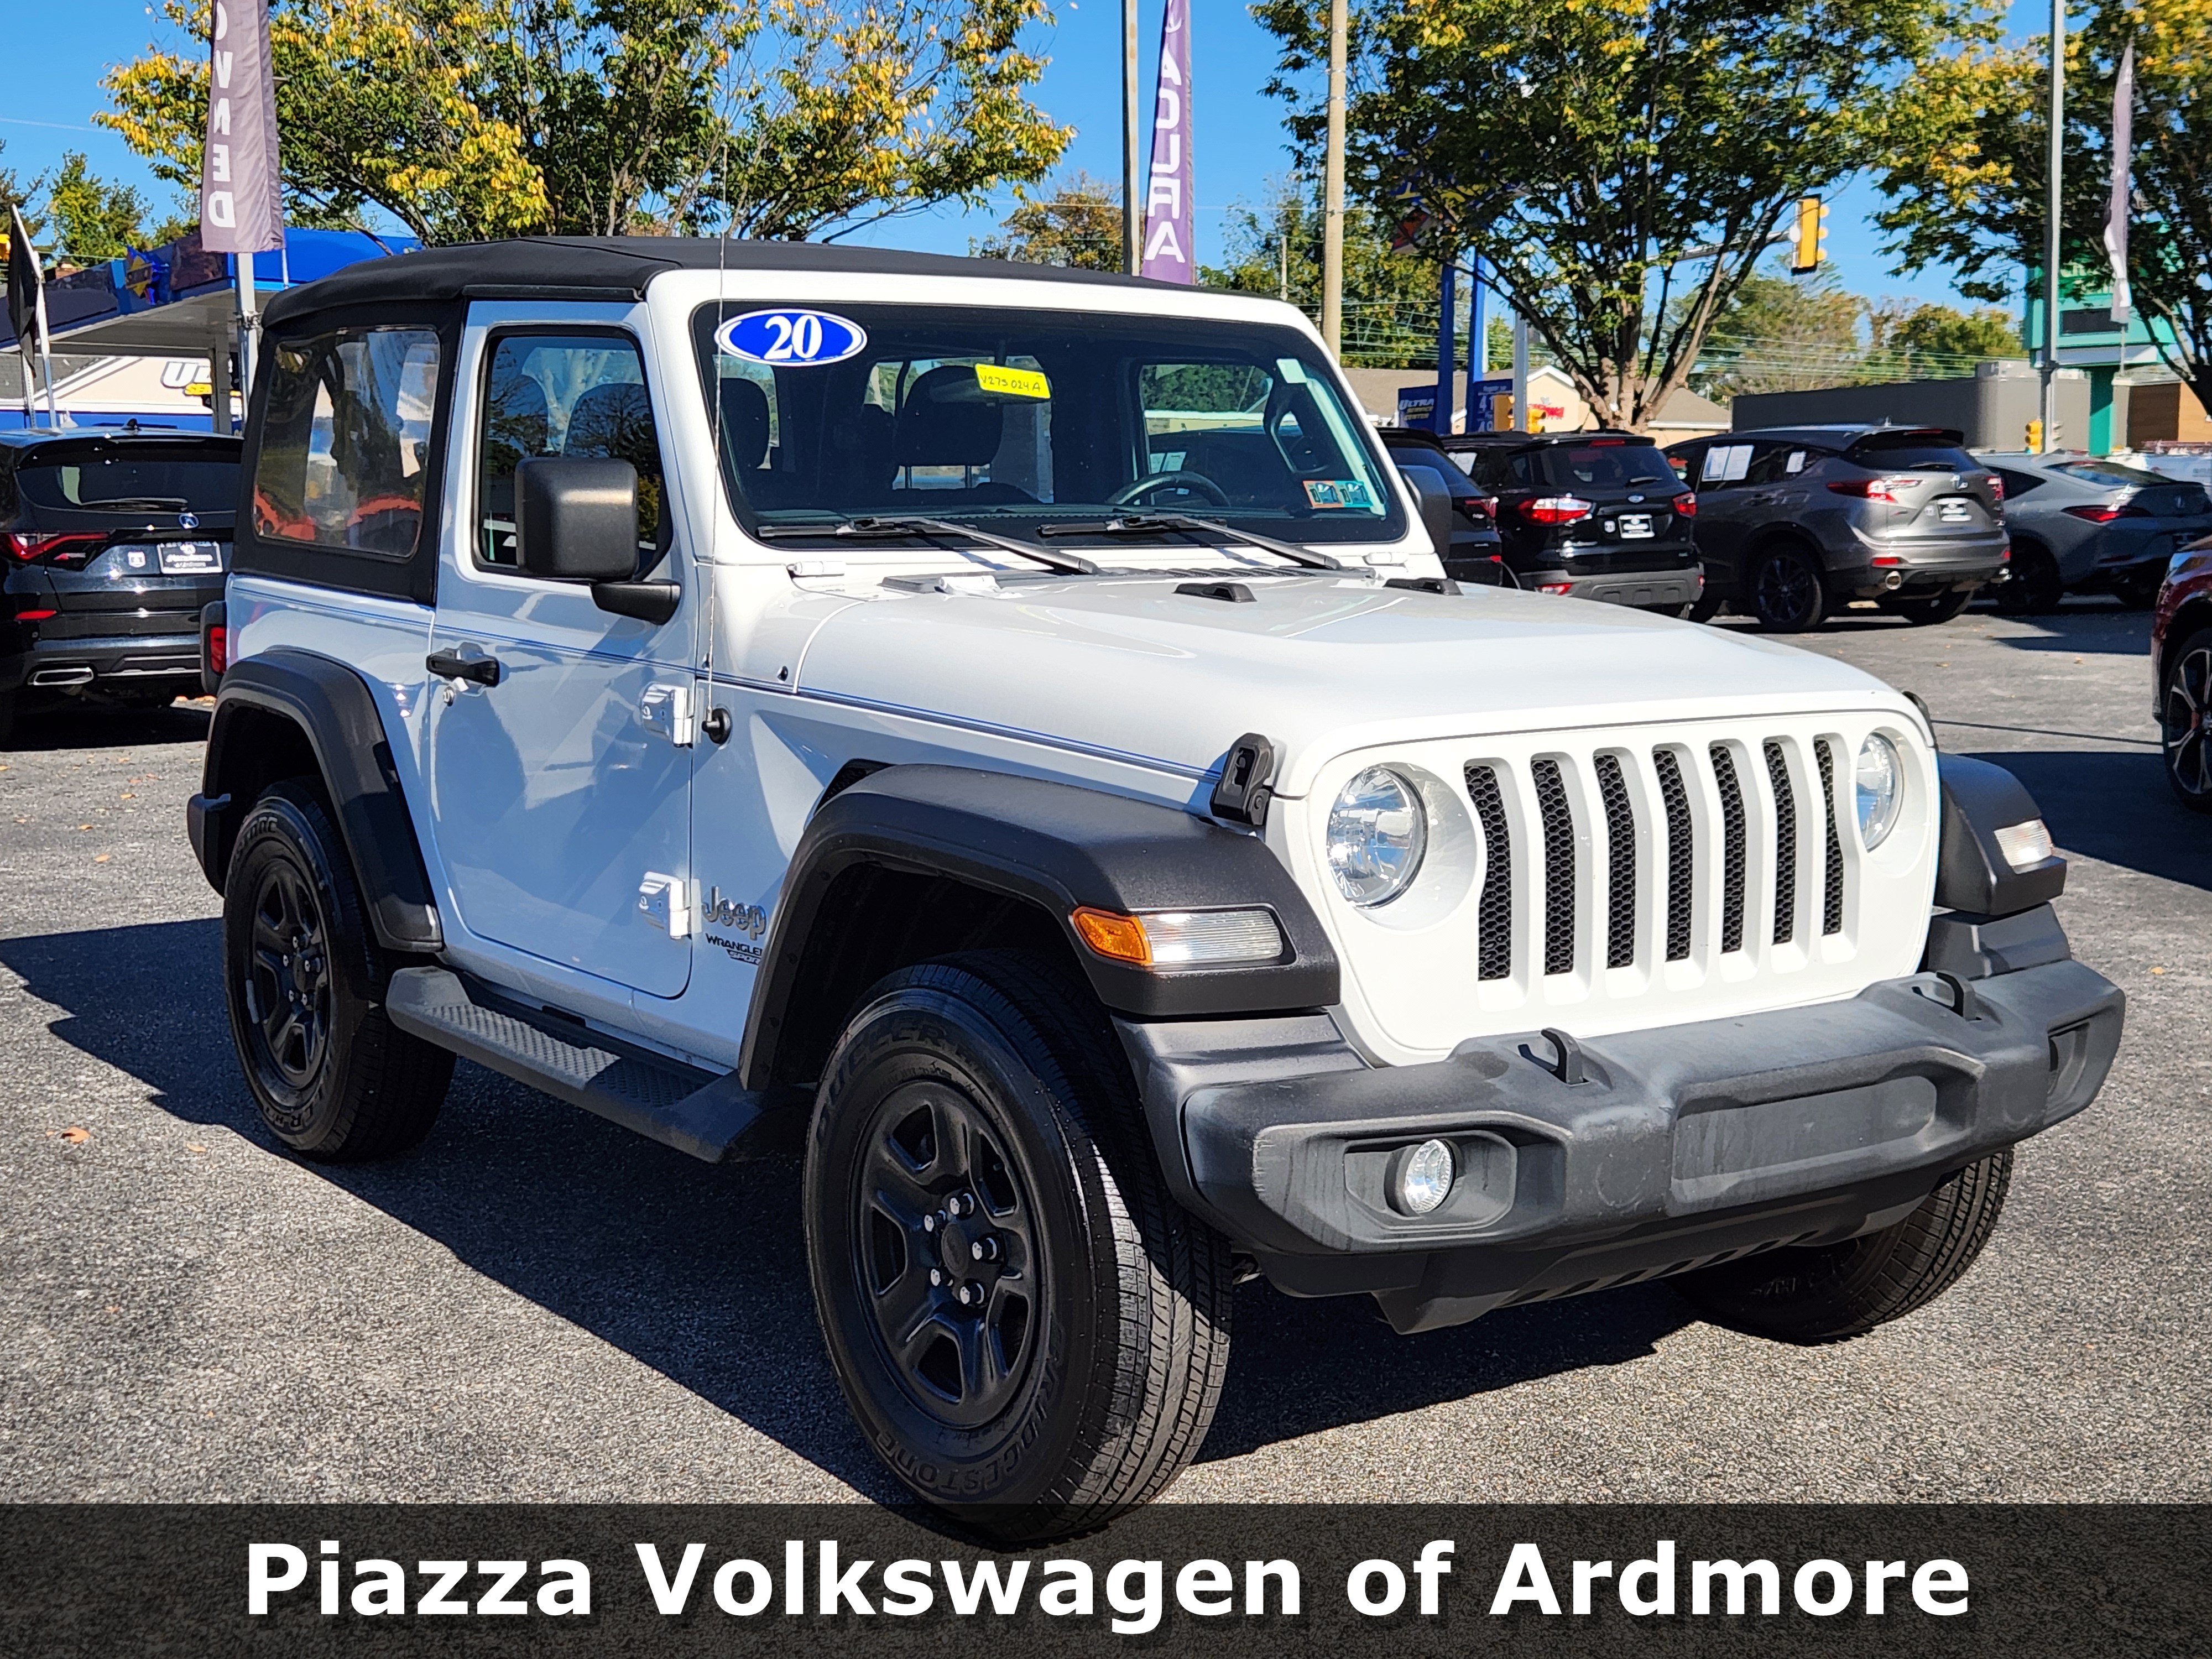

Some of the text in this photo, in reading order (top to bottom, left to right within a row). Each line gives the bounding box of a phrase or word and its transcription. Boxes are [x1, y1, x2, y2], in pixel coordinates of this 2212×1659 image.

[764, 314, 822, 359] 20
[1399, 398, 1434, 410] ULTRA
[701, 885, 767, 941] Jeep
[729, 951, 761, 965] SPOR
